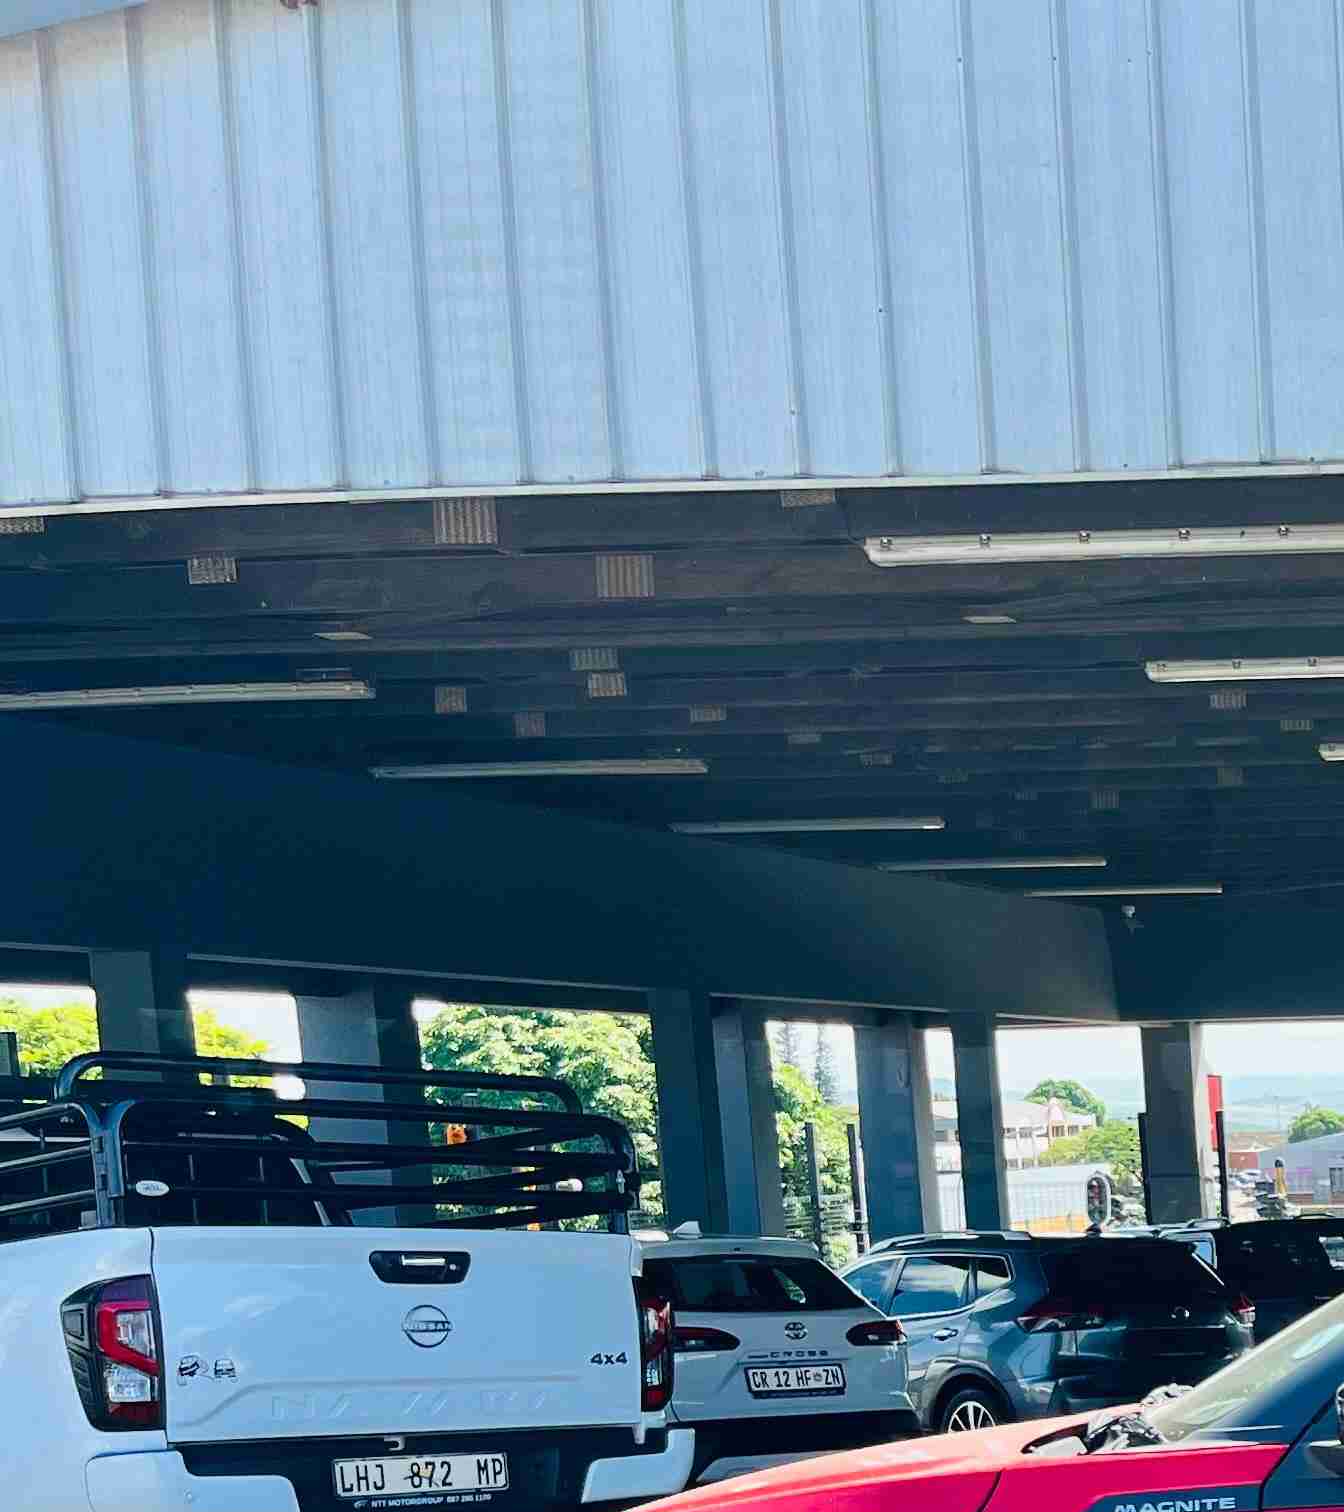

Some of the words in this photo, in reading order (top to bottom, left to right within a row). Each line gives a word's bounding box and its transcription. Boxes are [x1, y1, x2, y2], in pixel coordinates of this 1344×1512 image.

[590, 1352, 629, 1365] 4x4
[752, 1371, 770, 1389] CR
[774, 1371, 791, 1388] 12
[796, 1369, 812, 1387] HF
[823, 1367, 841, 1386] ZN
[338, 1463, 386, 1493] LHJ
[410, 1460, 453, 1489] 872
[476, 1457, 503, 1486] MP
